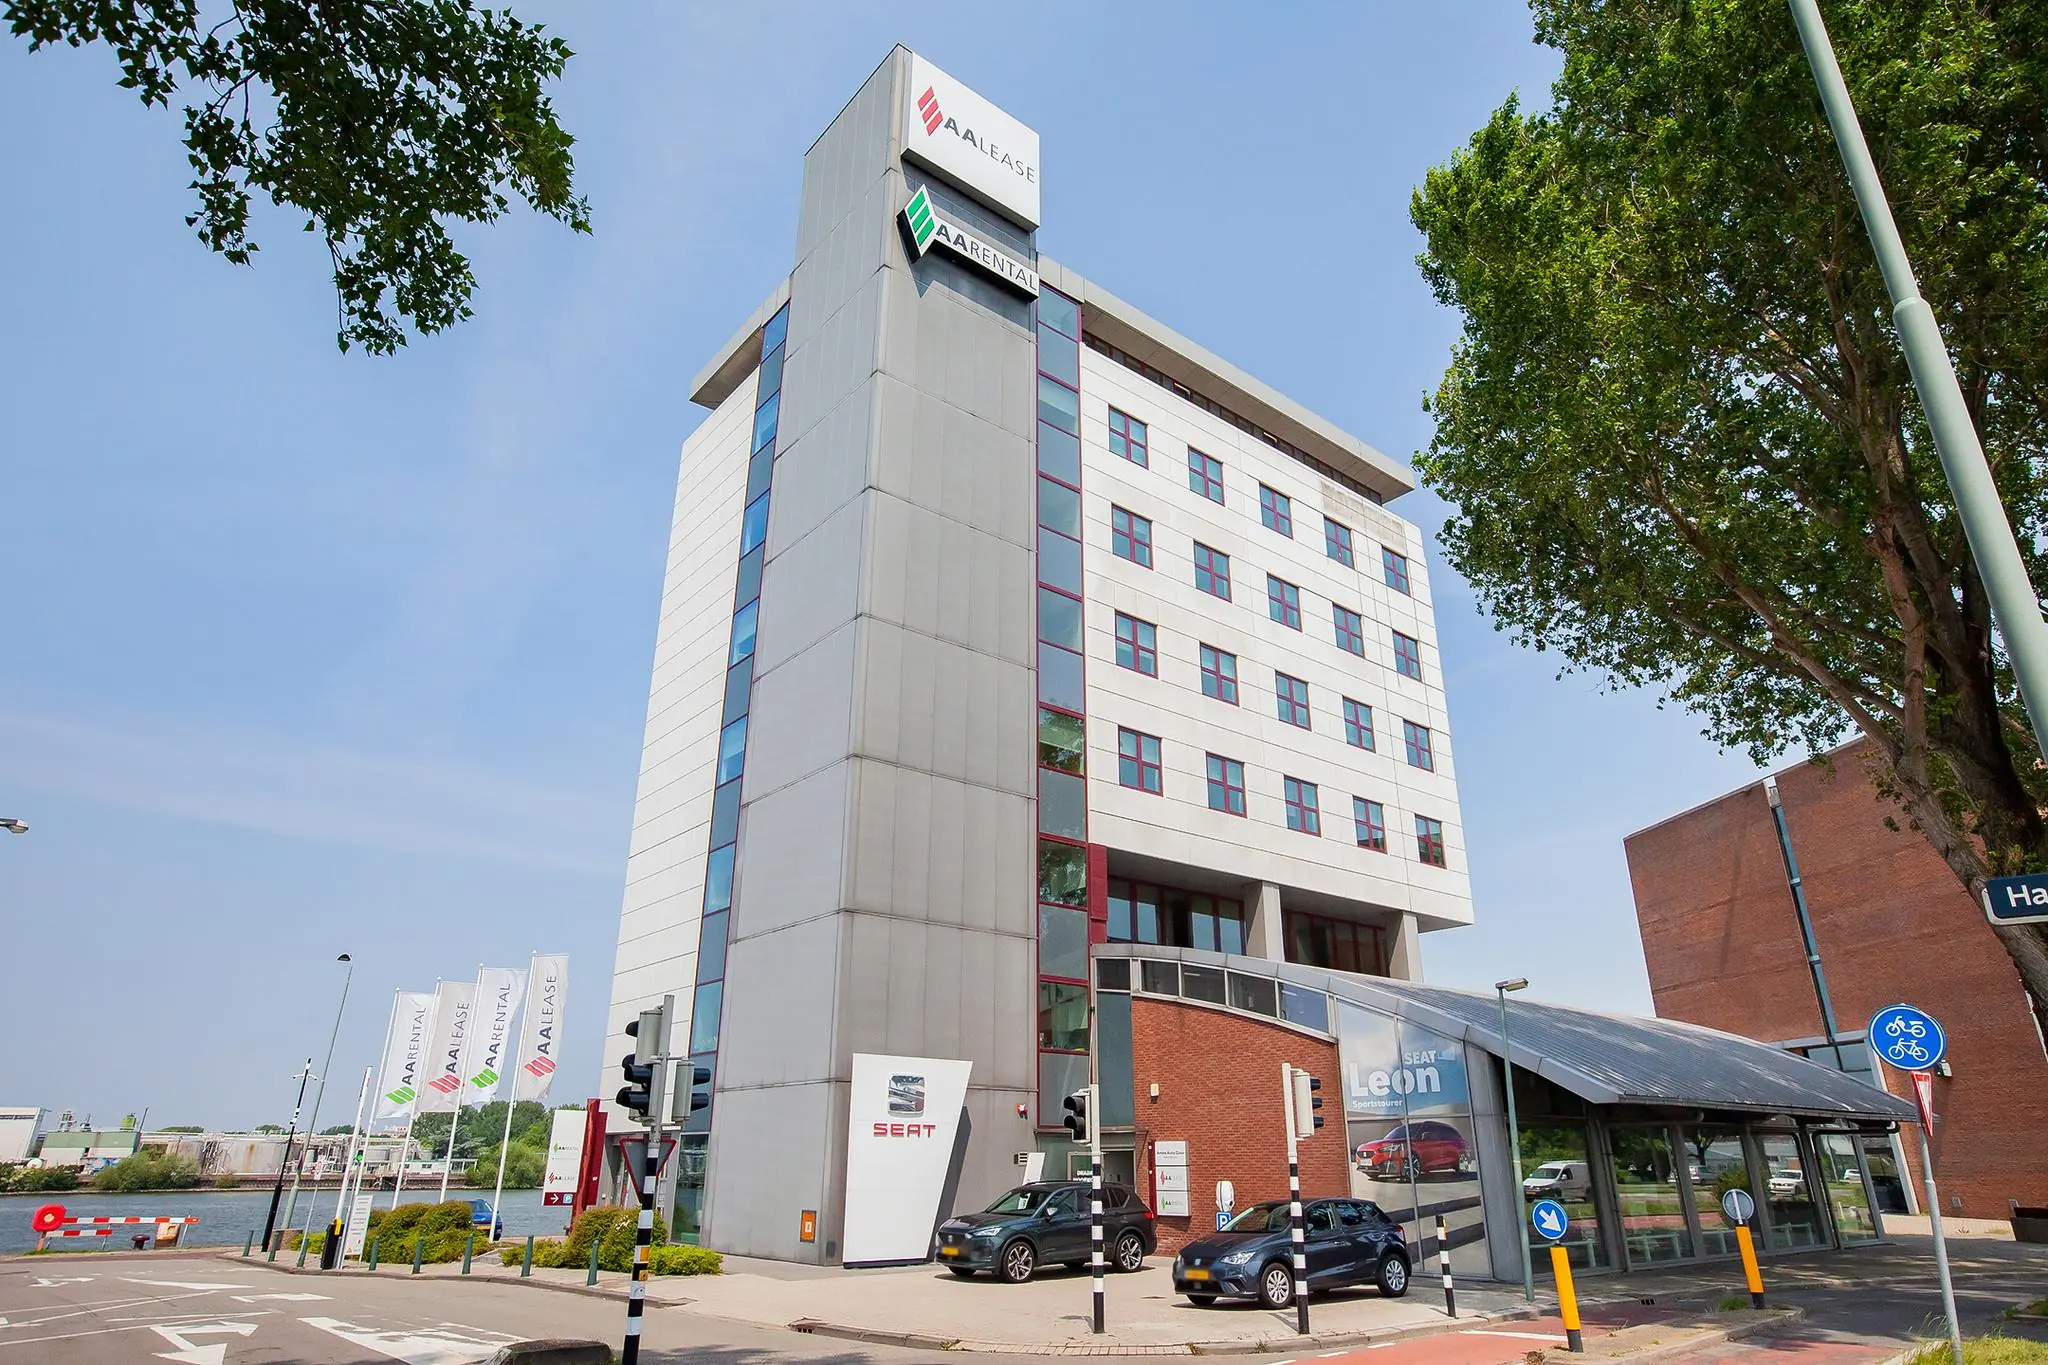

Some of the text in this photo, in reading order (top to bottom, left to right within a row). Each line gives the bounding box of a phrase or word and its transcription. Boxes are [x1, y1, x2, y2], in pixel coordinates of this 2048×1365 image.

[944, 117, 1035, 184] AALEASE
[936, 223, 1037, 292] AARENTAL
[2006, 884, 2048, 908] Ha
[445, 1002, 470, 1074] AALEASE
[485, 983, 511, 1068] AARENTAL
[536, 974, 557, 1055] AALEASE
[402, 1006, 427, 1086] AARENTAL
[1404, 1050, 1437, 1065] SEAT
[1349, 1062, 1441, 1097] Leon
[1352, 1099, 1403, 1109] Sportstourer
[873, 1123, 936, 1138] SEAT
[1220, 1215, 1228, 1229] P
